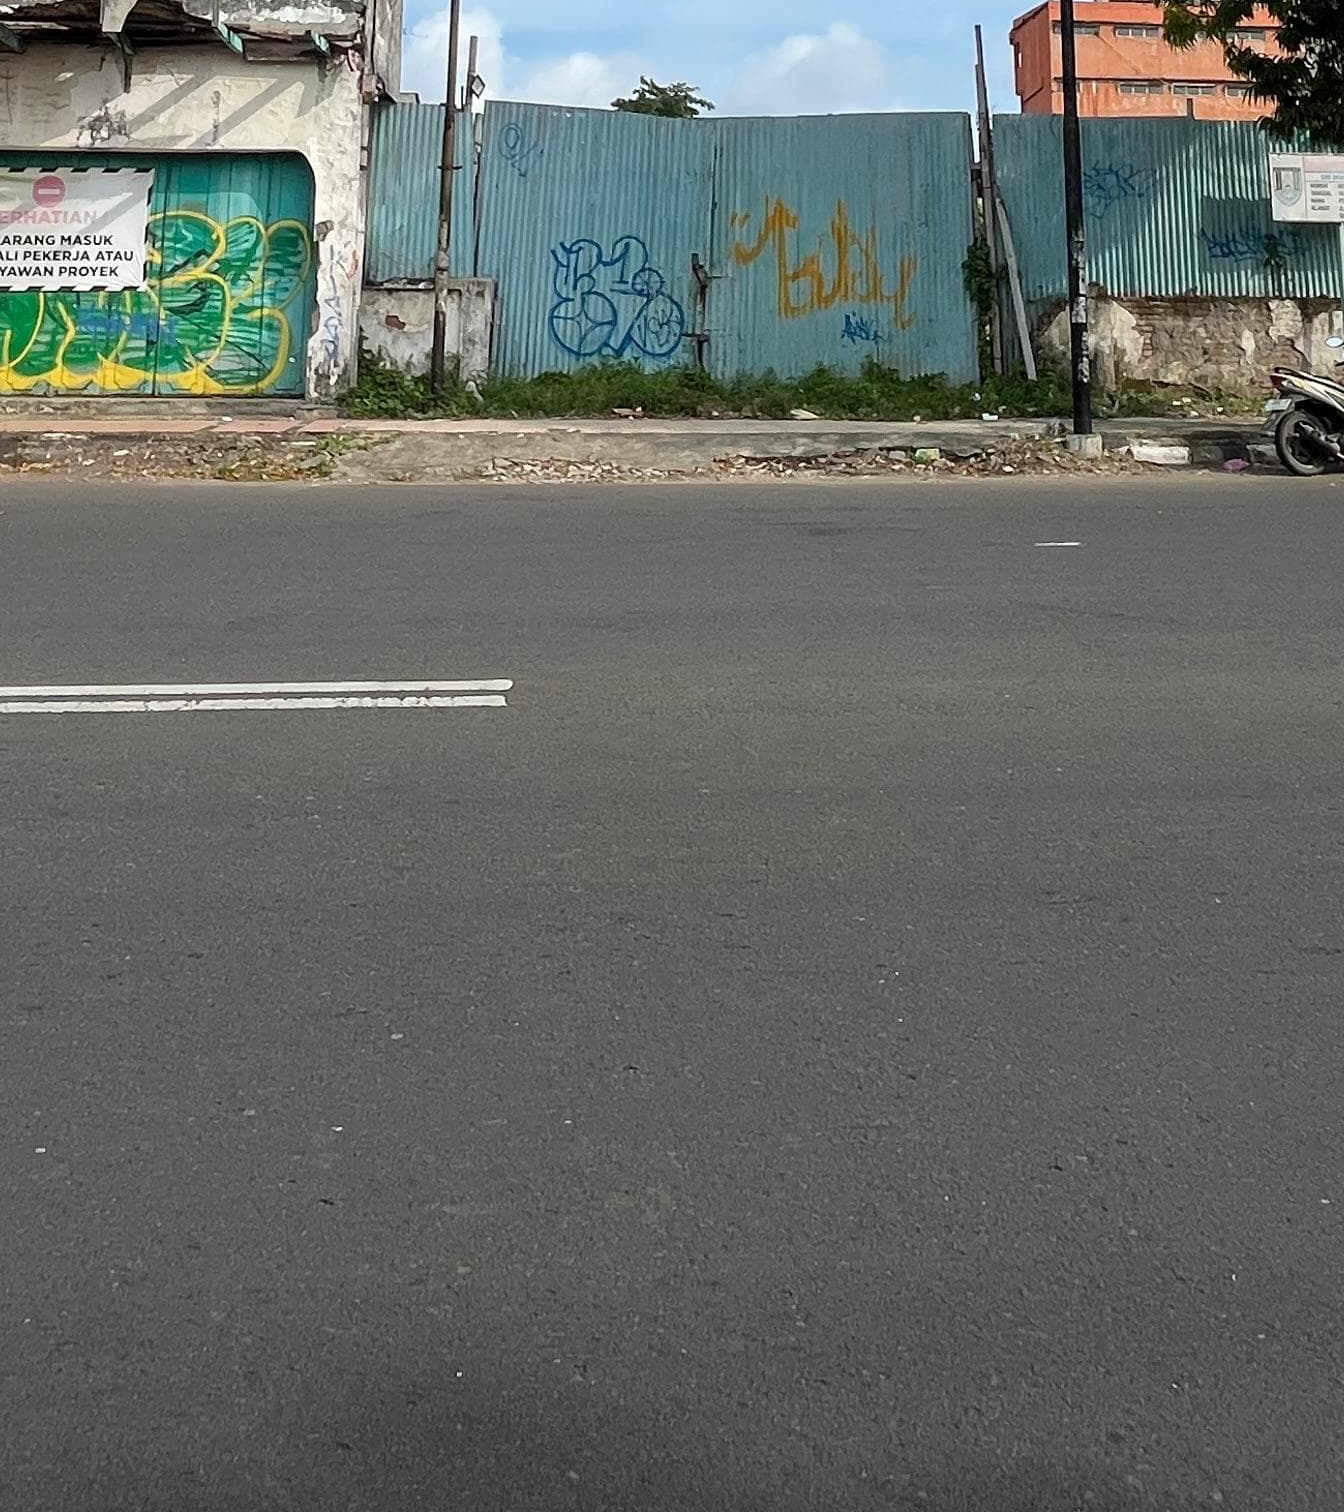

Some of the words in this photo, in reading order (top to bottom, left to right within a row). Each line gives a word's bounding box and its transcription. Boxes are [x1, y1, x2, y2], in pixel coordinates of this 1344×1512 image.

[60, 235, 113, 246] MASUK
[23, 250, 89, 261] PEKERJA
[94, 250, 134, 261] ATAU
[58, 266, 119, 277] PROYEK
